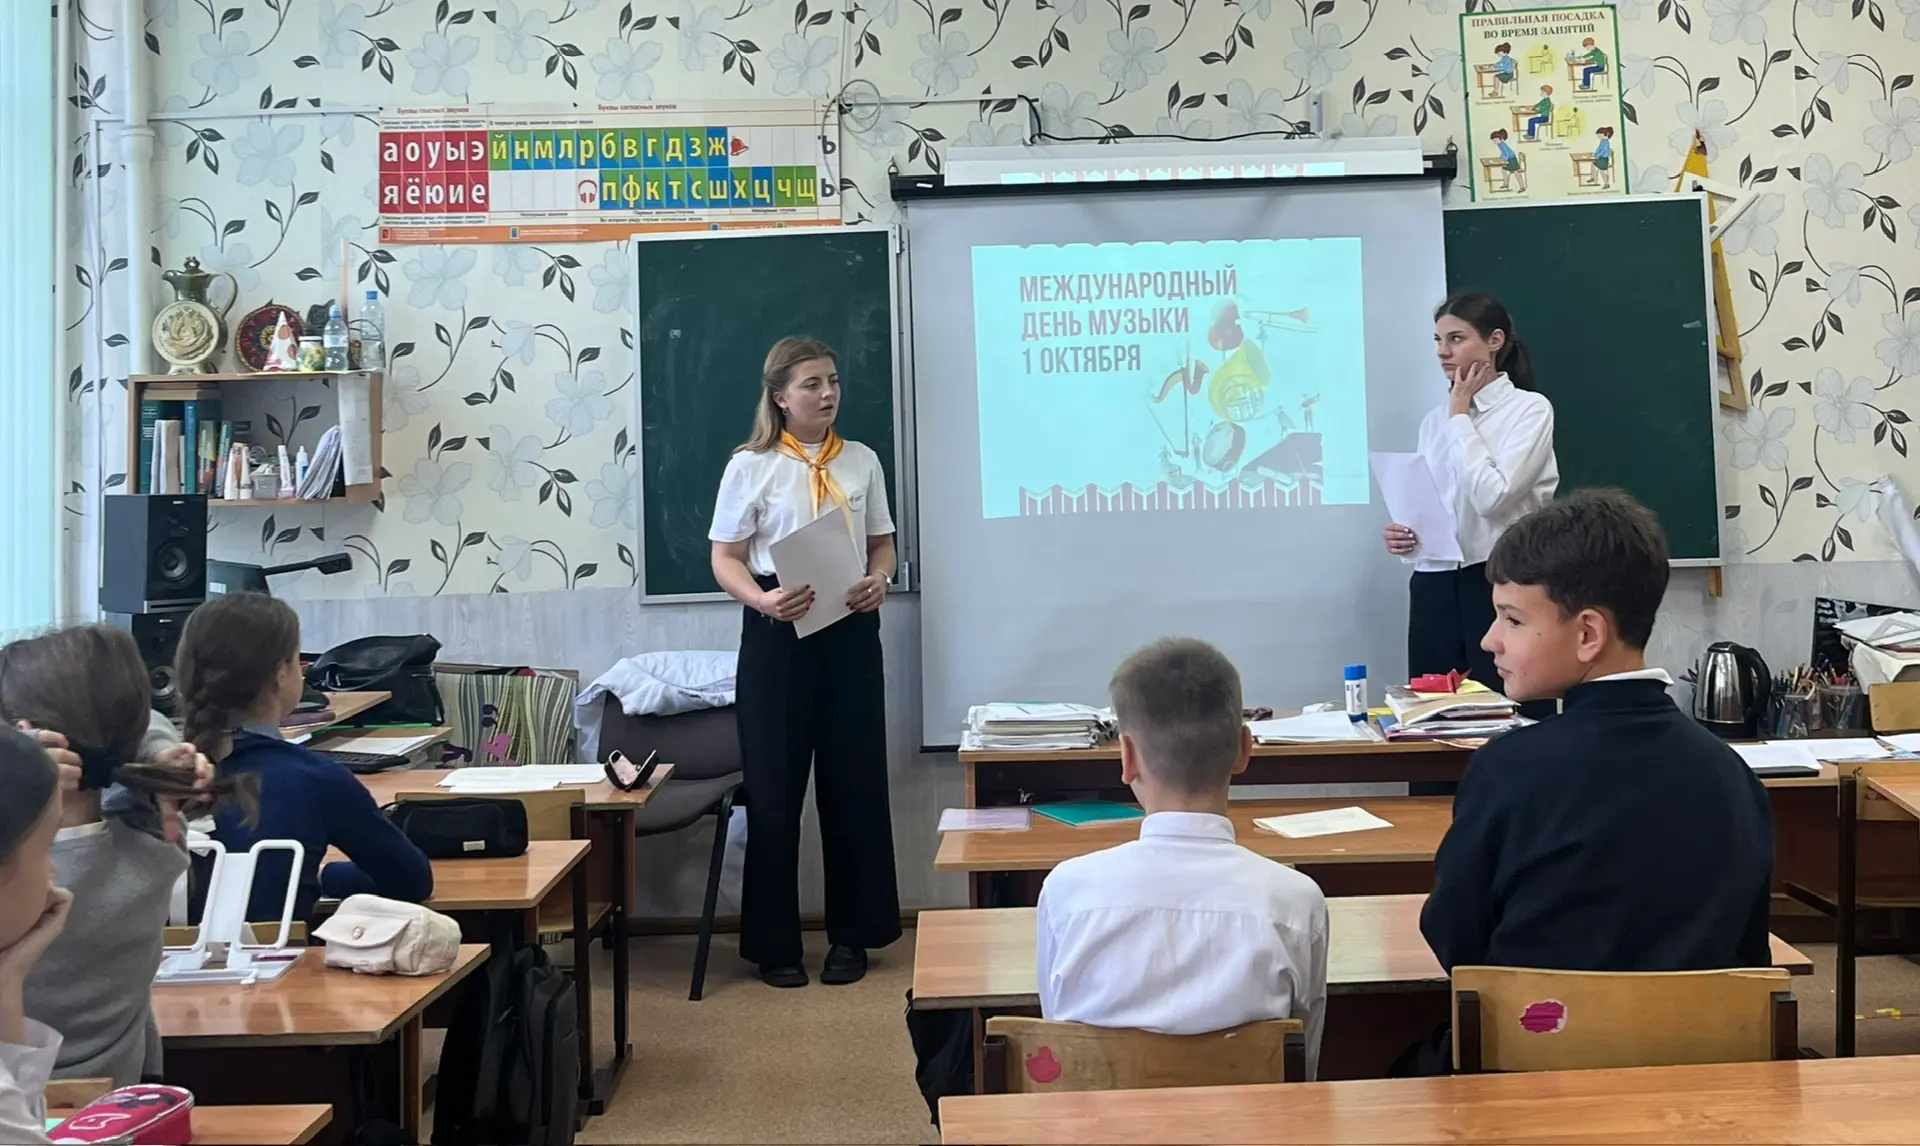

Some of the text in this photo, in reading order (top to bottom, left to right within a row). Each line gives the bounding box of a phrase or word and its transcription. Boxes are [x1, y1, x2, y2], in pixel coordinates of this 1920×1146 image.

[1471, 11, 1605, 27] ПРАВИЛЬНАЯ ПОСАДКА
[1483, 23, 1595, 39] ВО ВРЕМЯ ЗАНЯТИЙ
[1019, 264, 1238, 304] МЕЖДУНАРОДНЫЙ
[1021, 307, 1189, 341] ДЕНЬ МУЗЫКИ
[1022, 344, 1141, 375] 1 ОКТЯБРЯ
